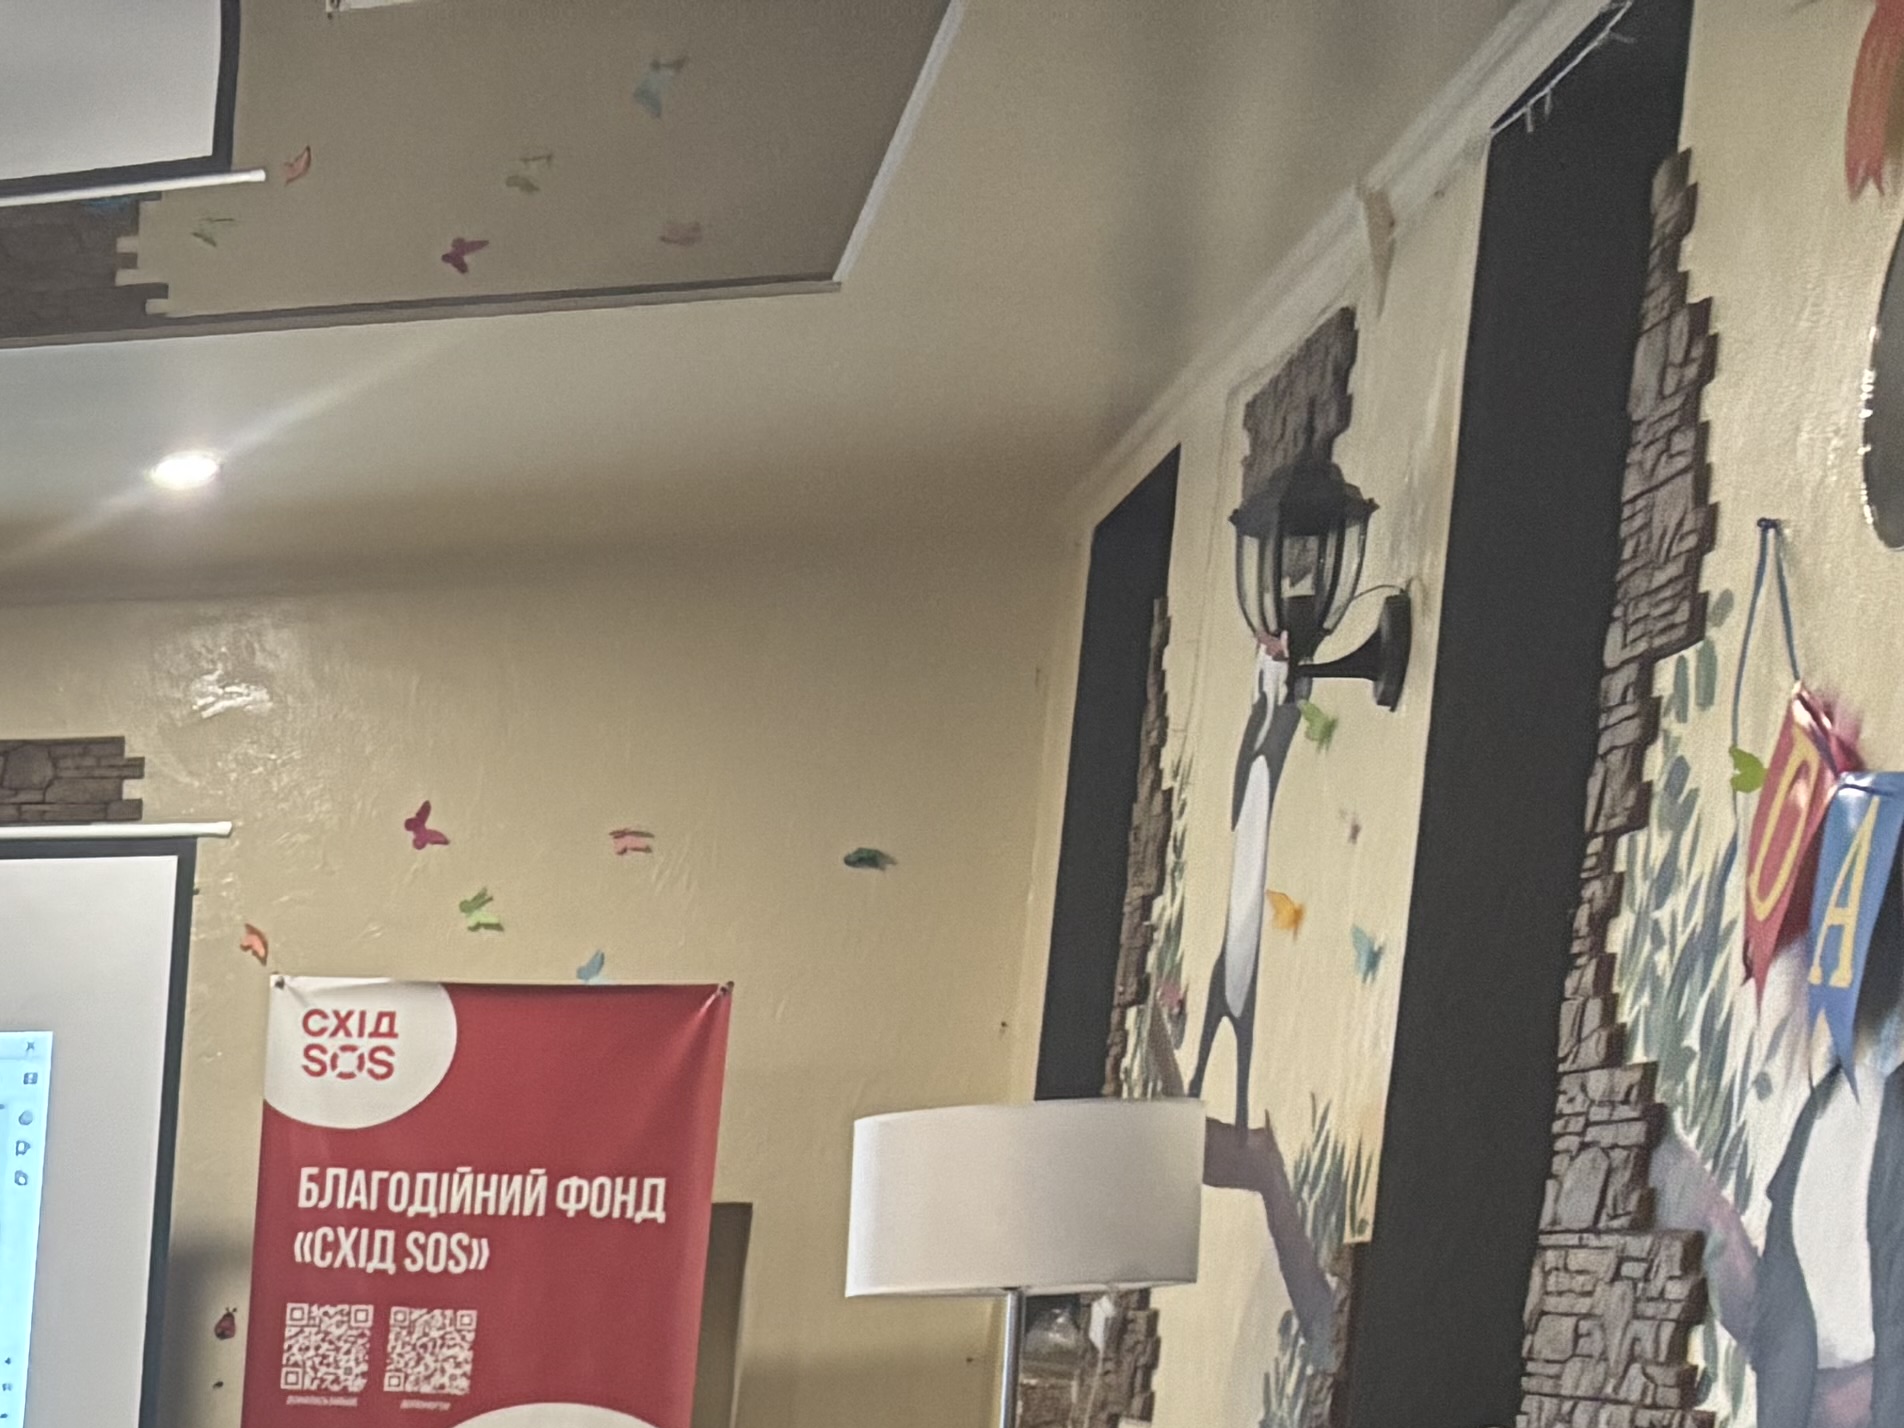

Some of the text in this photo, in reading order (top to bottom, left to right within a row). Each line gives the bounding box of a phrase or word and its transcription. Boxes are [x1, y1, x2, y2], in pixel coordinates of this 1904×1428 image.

[300, 1008, 399, 1040] СХІД
[300, 1043, 396, 1081] SOS
[296, 1166, 667, 1224] БЛАГОДІЙНИЙ ФОНД
[293, 1226, 491, 1275] «СХІД SOS»
